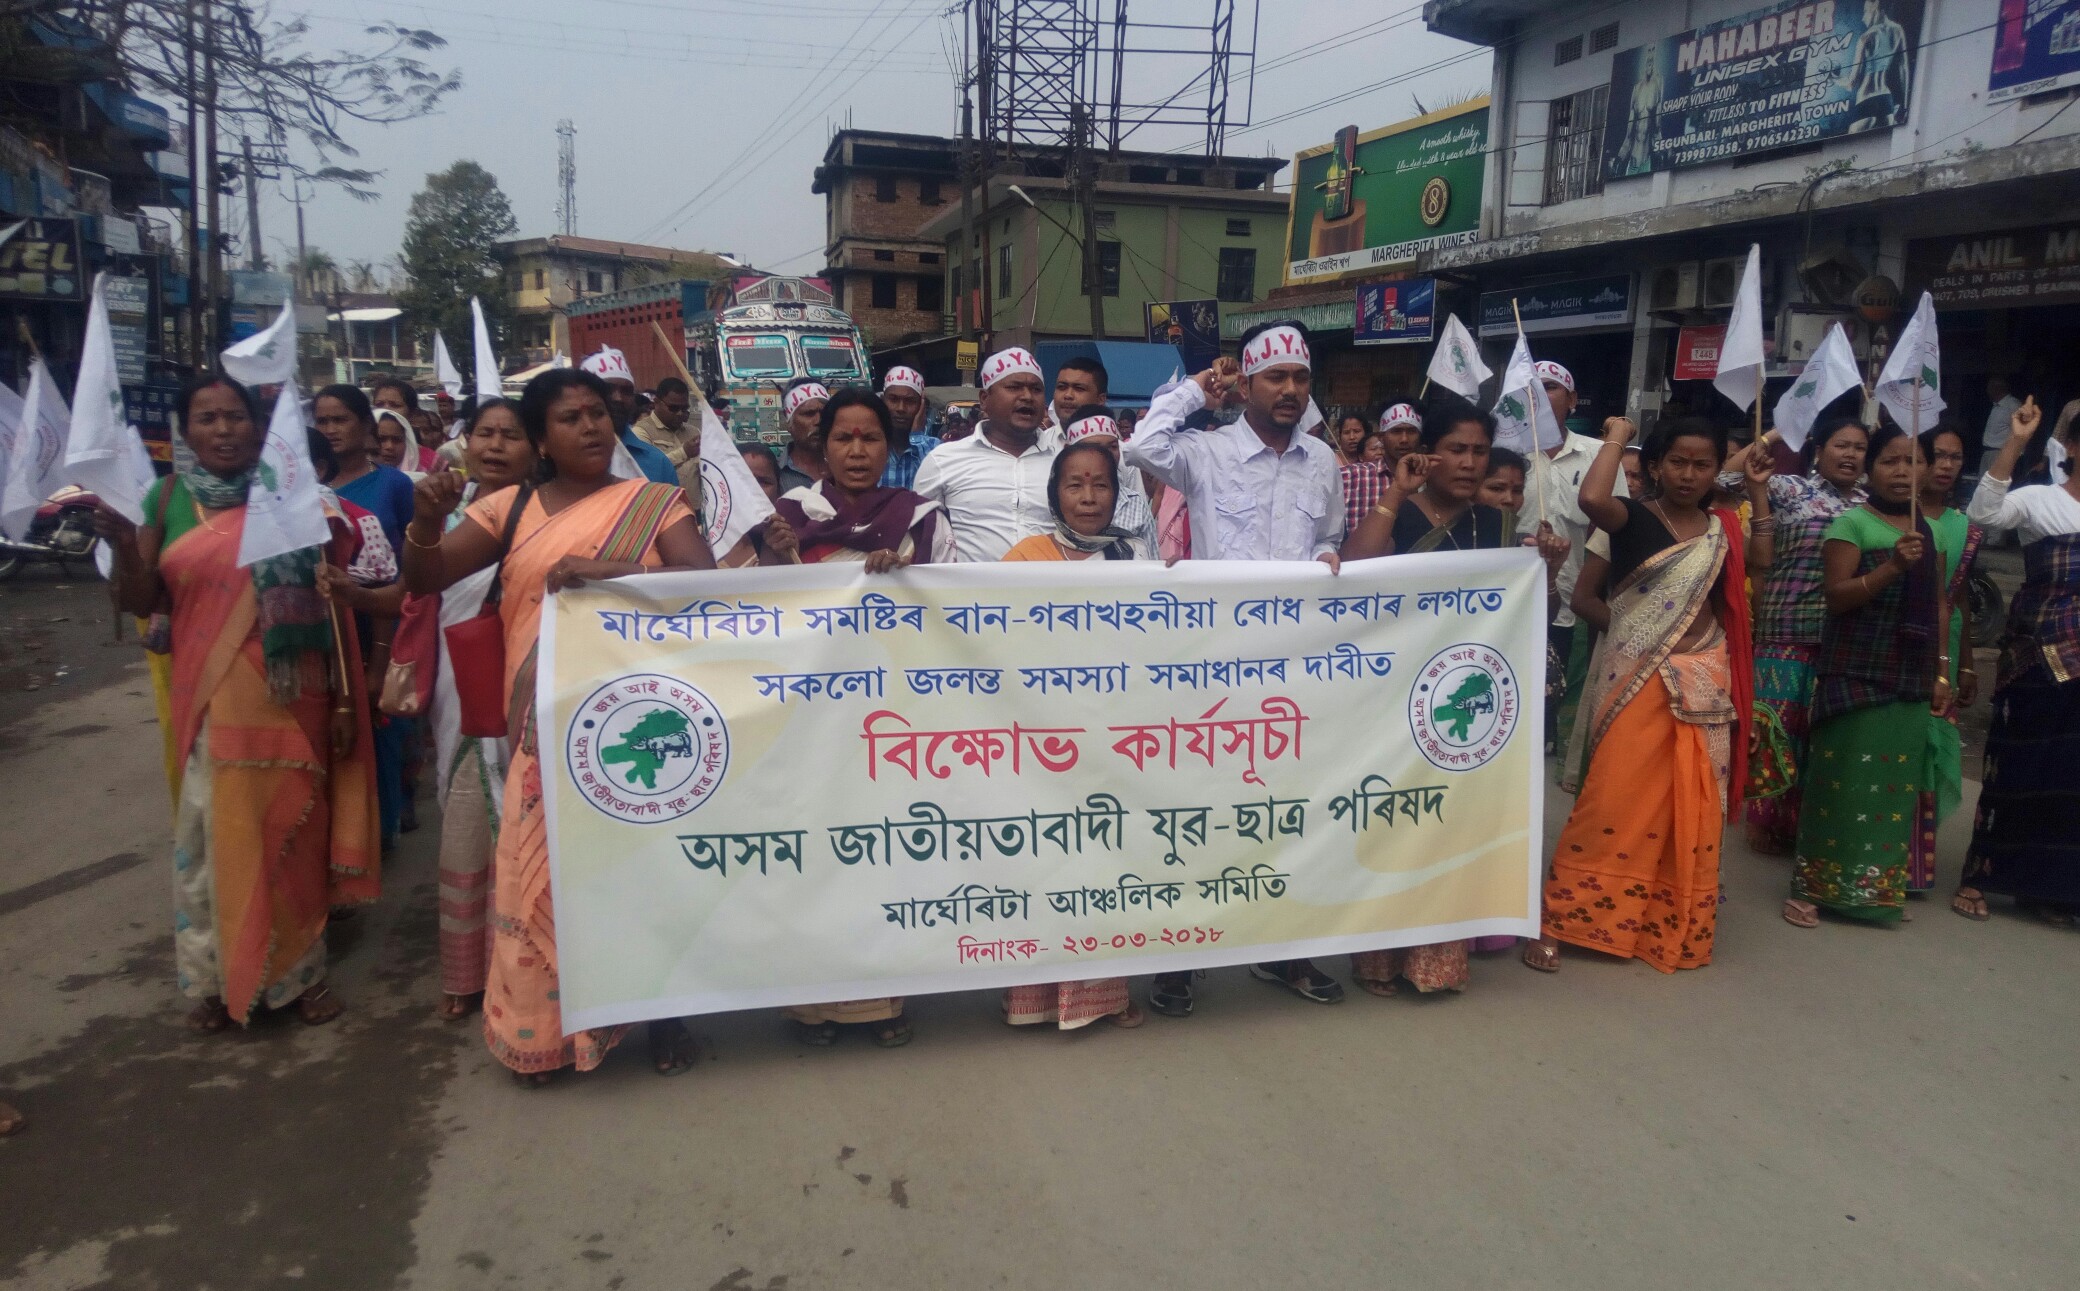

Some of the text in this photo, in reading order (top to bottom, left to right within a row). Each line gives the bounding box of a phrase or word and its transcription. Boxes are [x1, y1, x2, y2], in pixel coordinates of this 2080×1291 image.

[1677, 1, 1836, 72] MAHABEER
[1694, 32, 1853, 87] UNISEX GYM
[1690, 89, 1713, 109] YOUR
[1707, 82, 1828, 124] FITLESS TO FITNESS
[1721, 111, 1802, 137] MARGHERITA
[1804, 99, 1850, 122] TOWN
[1746, 124, 1820, 150] 9706542230
[1947, 237, 2023, 271] ANIL
[1933, 275, 1965, 288] DEALS
[1972, 274, 1983, 284] IN
[1990, 270, 2025, 282] PARTS
[1485, 305, 1513, 318] MAGIK
[1550, 296, 1583, 310] MAGIK
[800, 592, 928, 637] সমষ্টিৰ
[1234, 595, 1304, 628] ৰোধ
[1318, 591, 1406, 623] কৰাৰ
[1417, 586, 1506, 616] লগতে
[752, 642, 1396, 703] সকলো জলন্ত সমস্যা সমাধানৰ দাবীত
[859, 709, 1087, 782] বিক্ষোভ
[676, 829, 809, 878] অসম
[827, 793, 1130, 867] জাতীয়তাবাদী
[1328, 774, 1449, 834] পৰিষদ
[1045, 873, 1185, 918] আঞ্চলিক
[1195, 864, 1291, 905] সমিতি
[1063, 926, 1225, 955] ২৩-০৩-২০১৮
